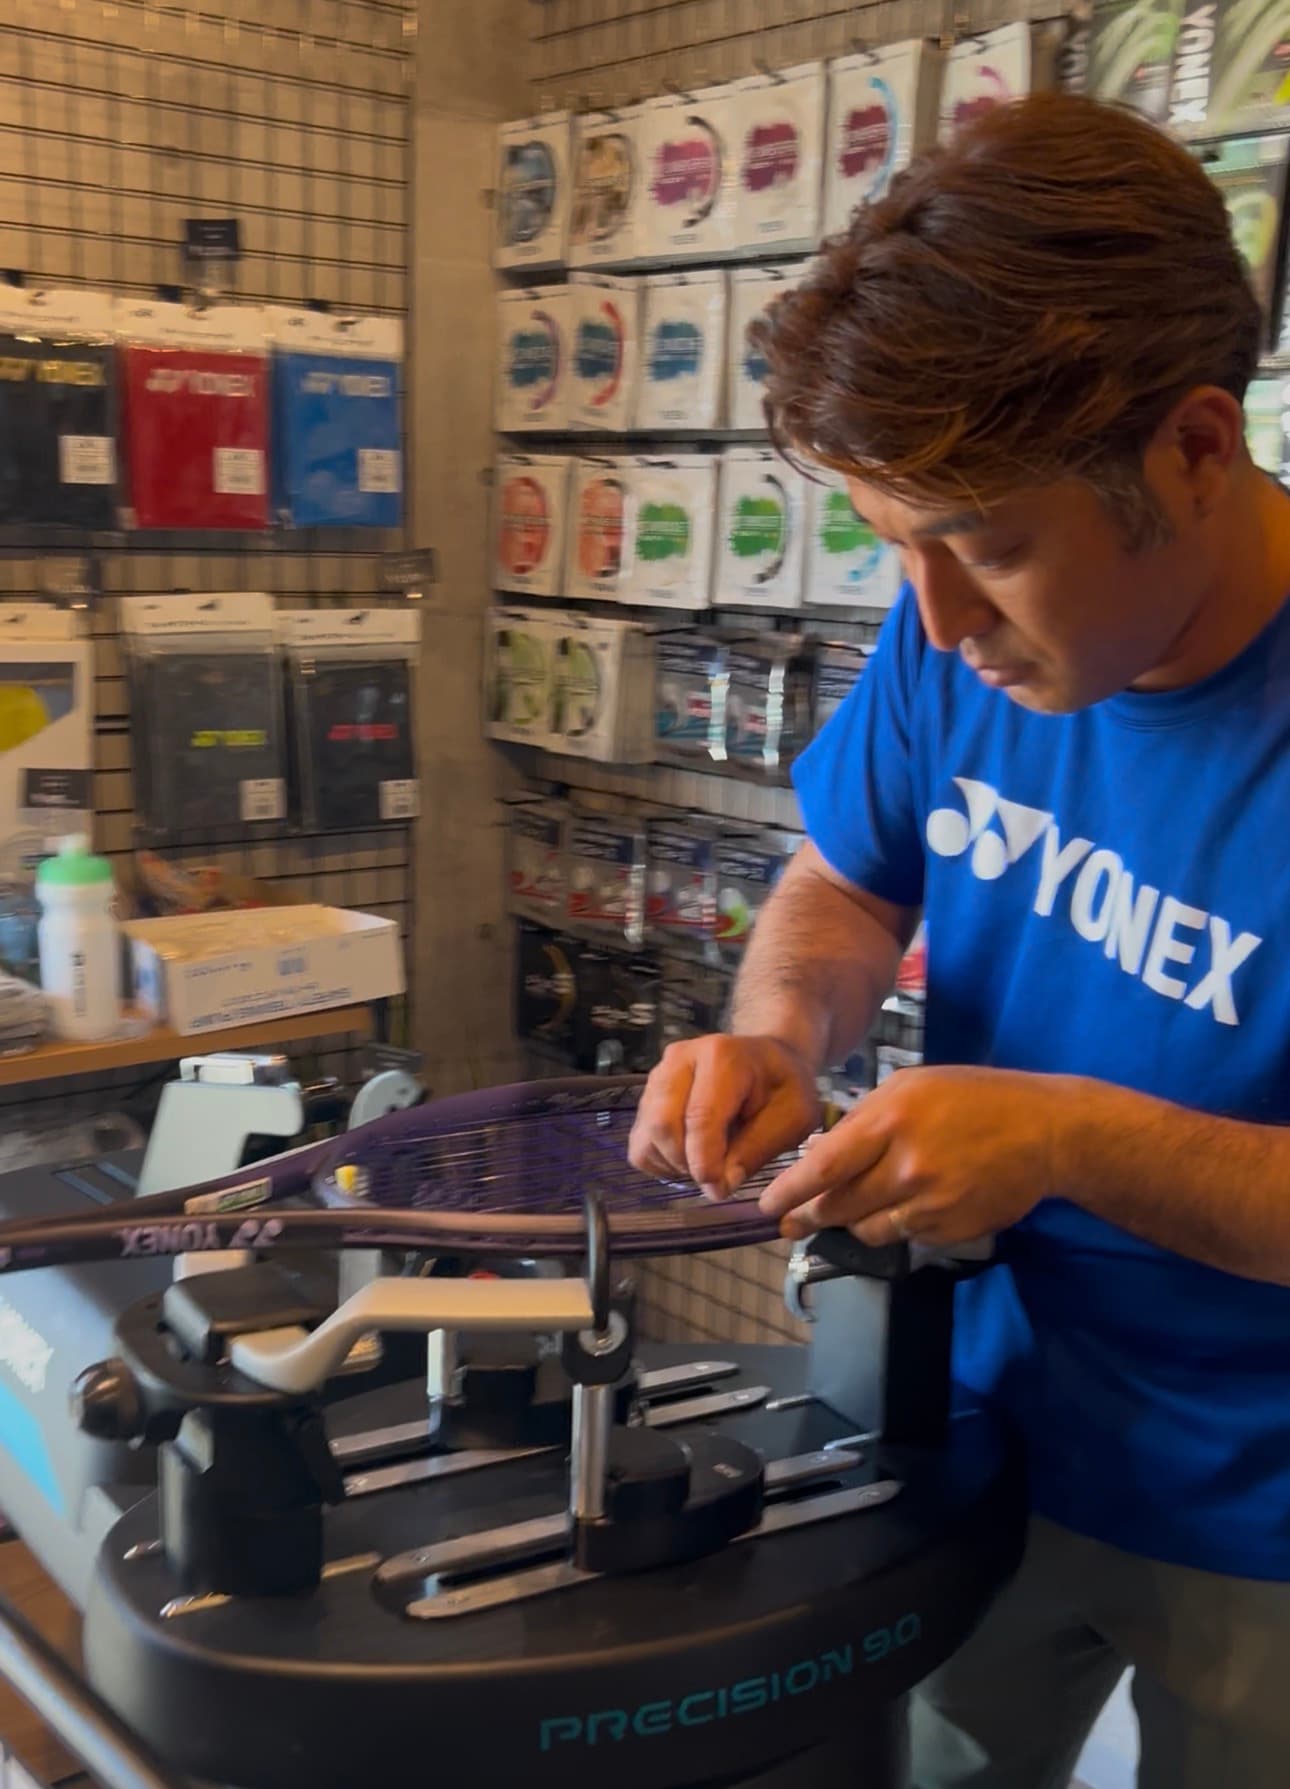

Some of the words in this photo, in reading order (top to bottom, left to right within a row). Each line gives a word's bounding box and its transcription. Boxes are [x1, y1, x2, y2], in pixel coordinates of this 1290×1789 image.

[1034, 824, 1263, 1026] YONEX
[119, 1223, 219, 1256] YONEX
[539, 1644, 854, 1751] PRECISION
